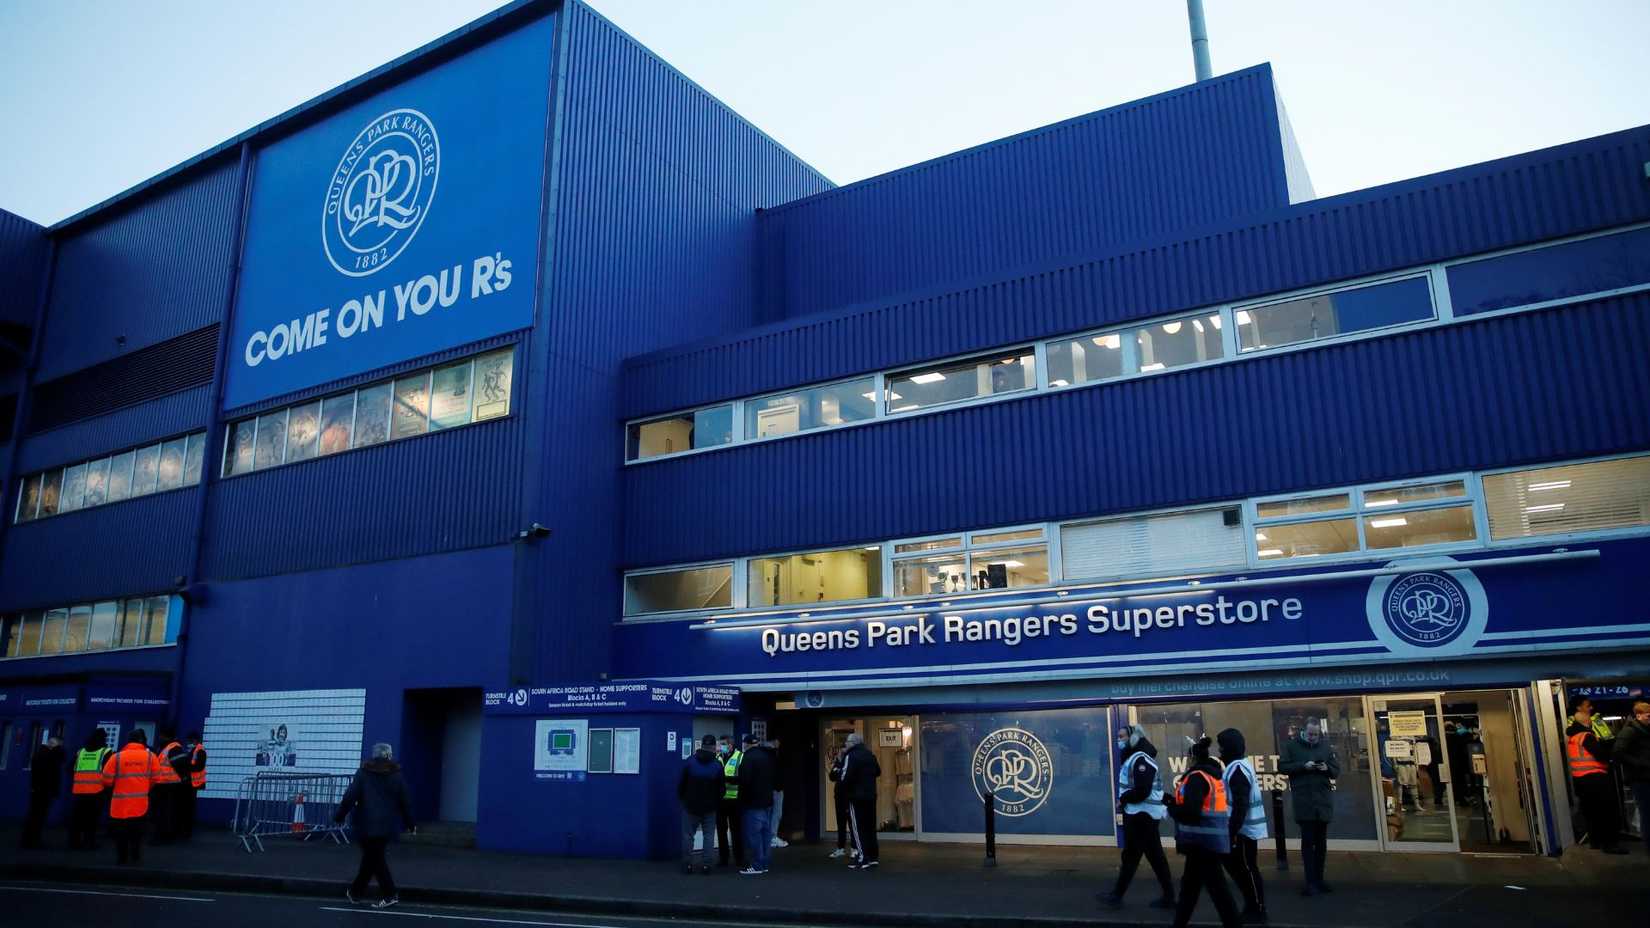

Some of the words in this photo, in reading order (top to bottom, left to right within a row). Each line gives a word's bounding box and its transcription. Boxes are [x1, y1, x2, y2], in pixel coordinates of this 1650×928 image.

[328, 142, 364, 214] QUEENS
[367, 116, 400, 142] PARK
[402, 116, 435, 176] RANGERS
[355, 247, 389, 269] 1882
[245, 308, 330, 367] COME
[336, 290, 385, 338] ON
[393, 265, 462, 321] YOU
[1391, 582, 1409, 612] QUEENS
[1410, 576, 1431, 585] PARK
[1433, 577, 1462, 608] RANGERS
[762, 629, 859, 656] Queens
[867, 618, 936, 648] Park
[943, 613, 1078, 645] Rangers
[1087, 596, 1302, 637] Superstore
[507, 692, 514, 704] 4
[547, 687, 564, 695] AFRICA
[615, 684, 648, 692] SUPPORTERS
[673, 689, 681, 702] 4
[975, 737, 996, 775] QUEENS
[997, 731, 1020, 741] PARK
[1021, 733, 1049, 777] RANGERS
[1002, 804, 1025, 813] 1882
